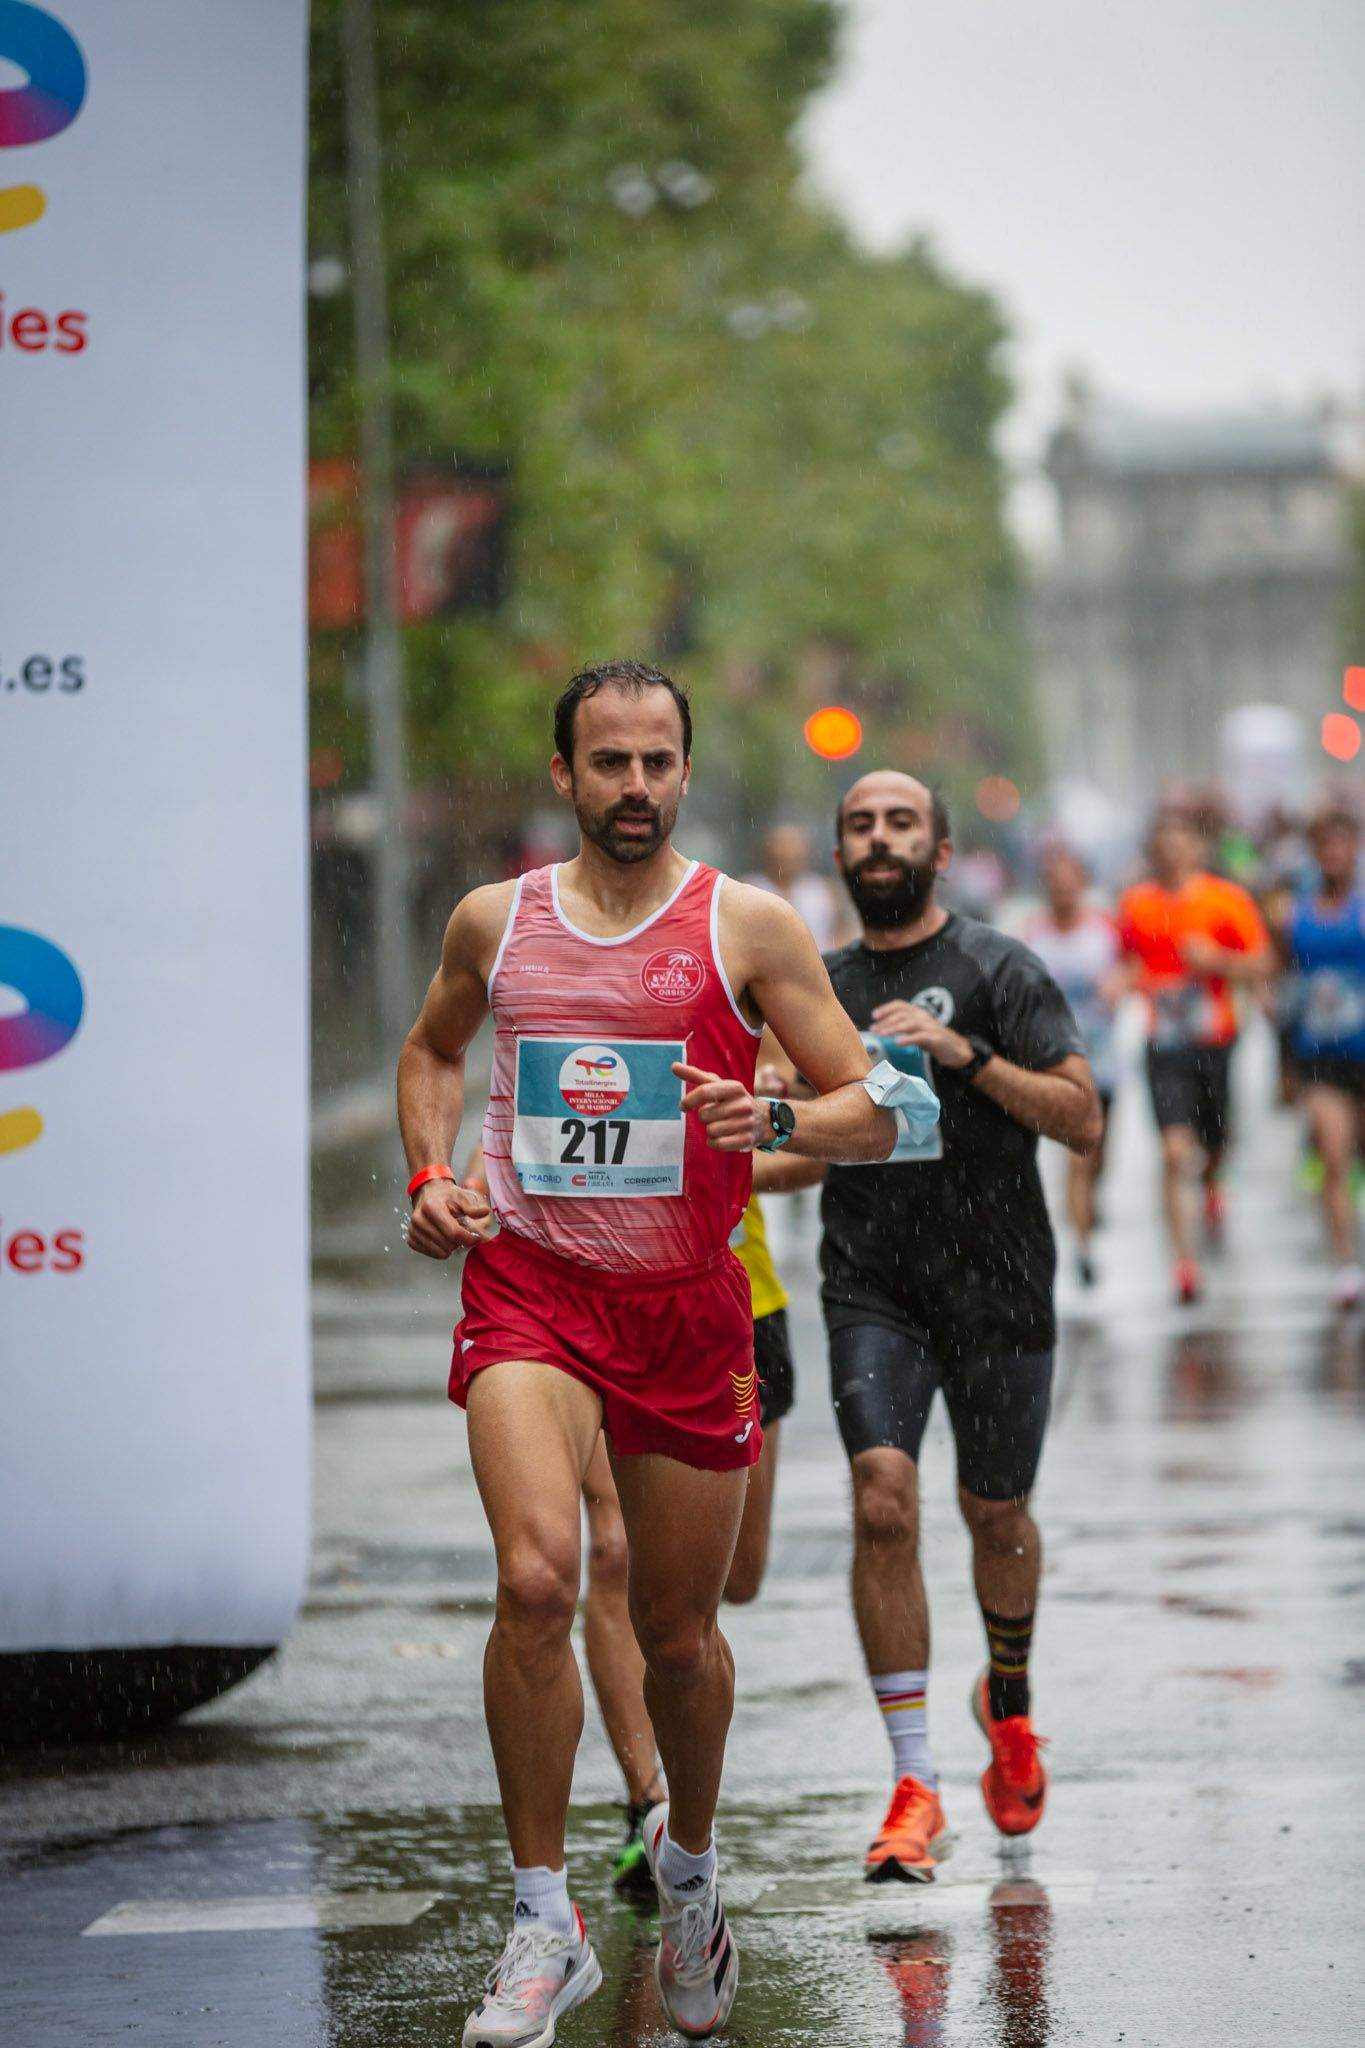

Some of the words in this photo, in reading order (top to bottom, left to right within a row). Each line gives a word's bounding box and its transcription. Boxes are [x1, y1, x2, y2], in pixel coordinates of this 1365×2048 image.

[569, 1097, 620, 1105] INTERNACIONAL
[560, 1118, 631, 1165] 217
[528, 1174, 562, 1184] MADRID
[0, 1219, 83, 1273] es
